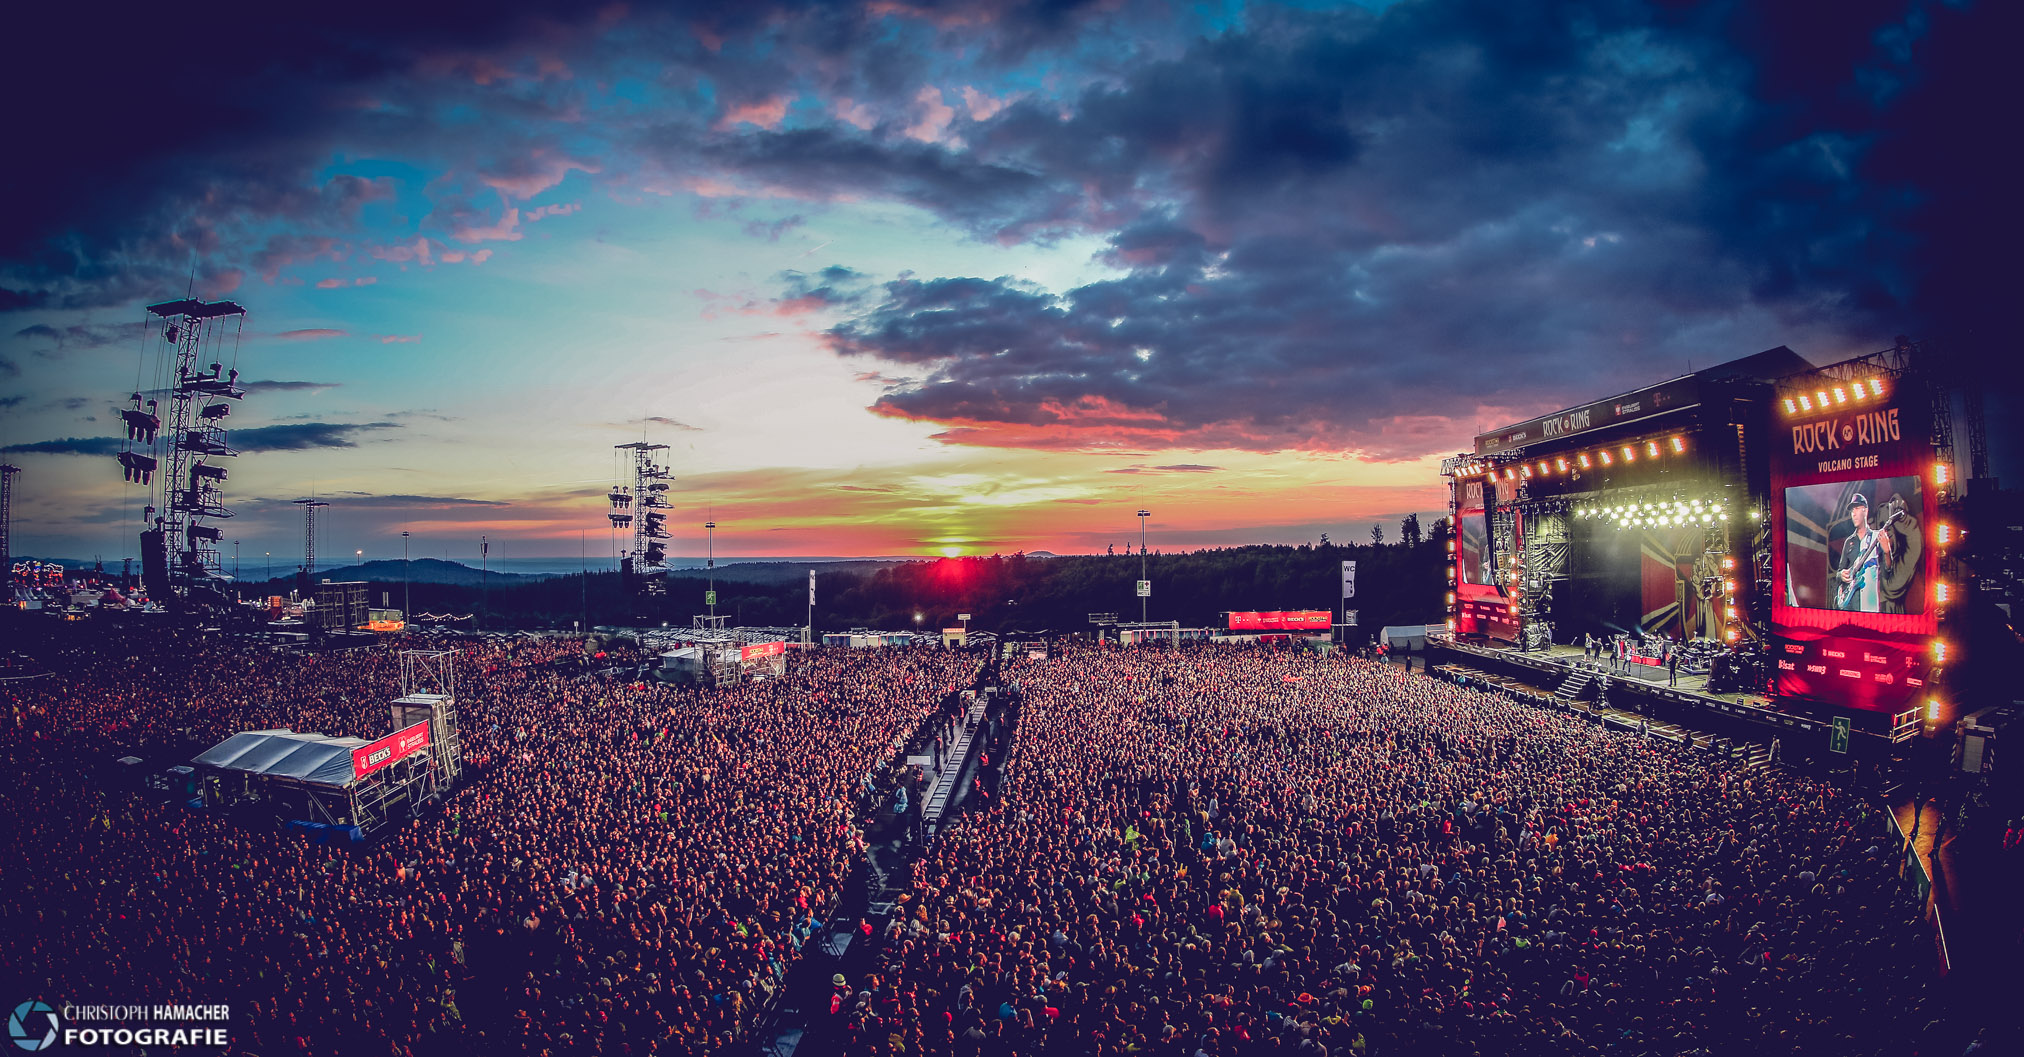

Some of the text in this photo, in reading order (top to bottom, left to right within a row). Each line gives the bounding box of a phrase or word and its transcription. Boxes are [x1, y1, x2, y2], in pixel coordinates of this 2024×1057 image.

[1543, 410, 1590, 437] ROCK RING
[1792, 419, 1840, 455] ROCK
[1856, 408, 1900, 446] RING
[1818, 455, 1879, 473] VOLCANO STAGE
[368, 746, 391, 765] BECK'S
